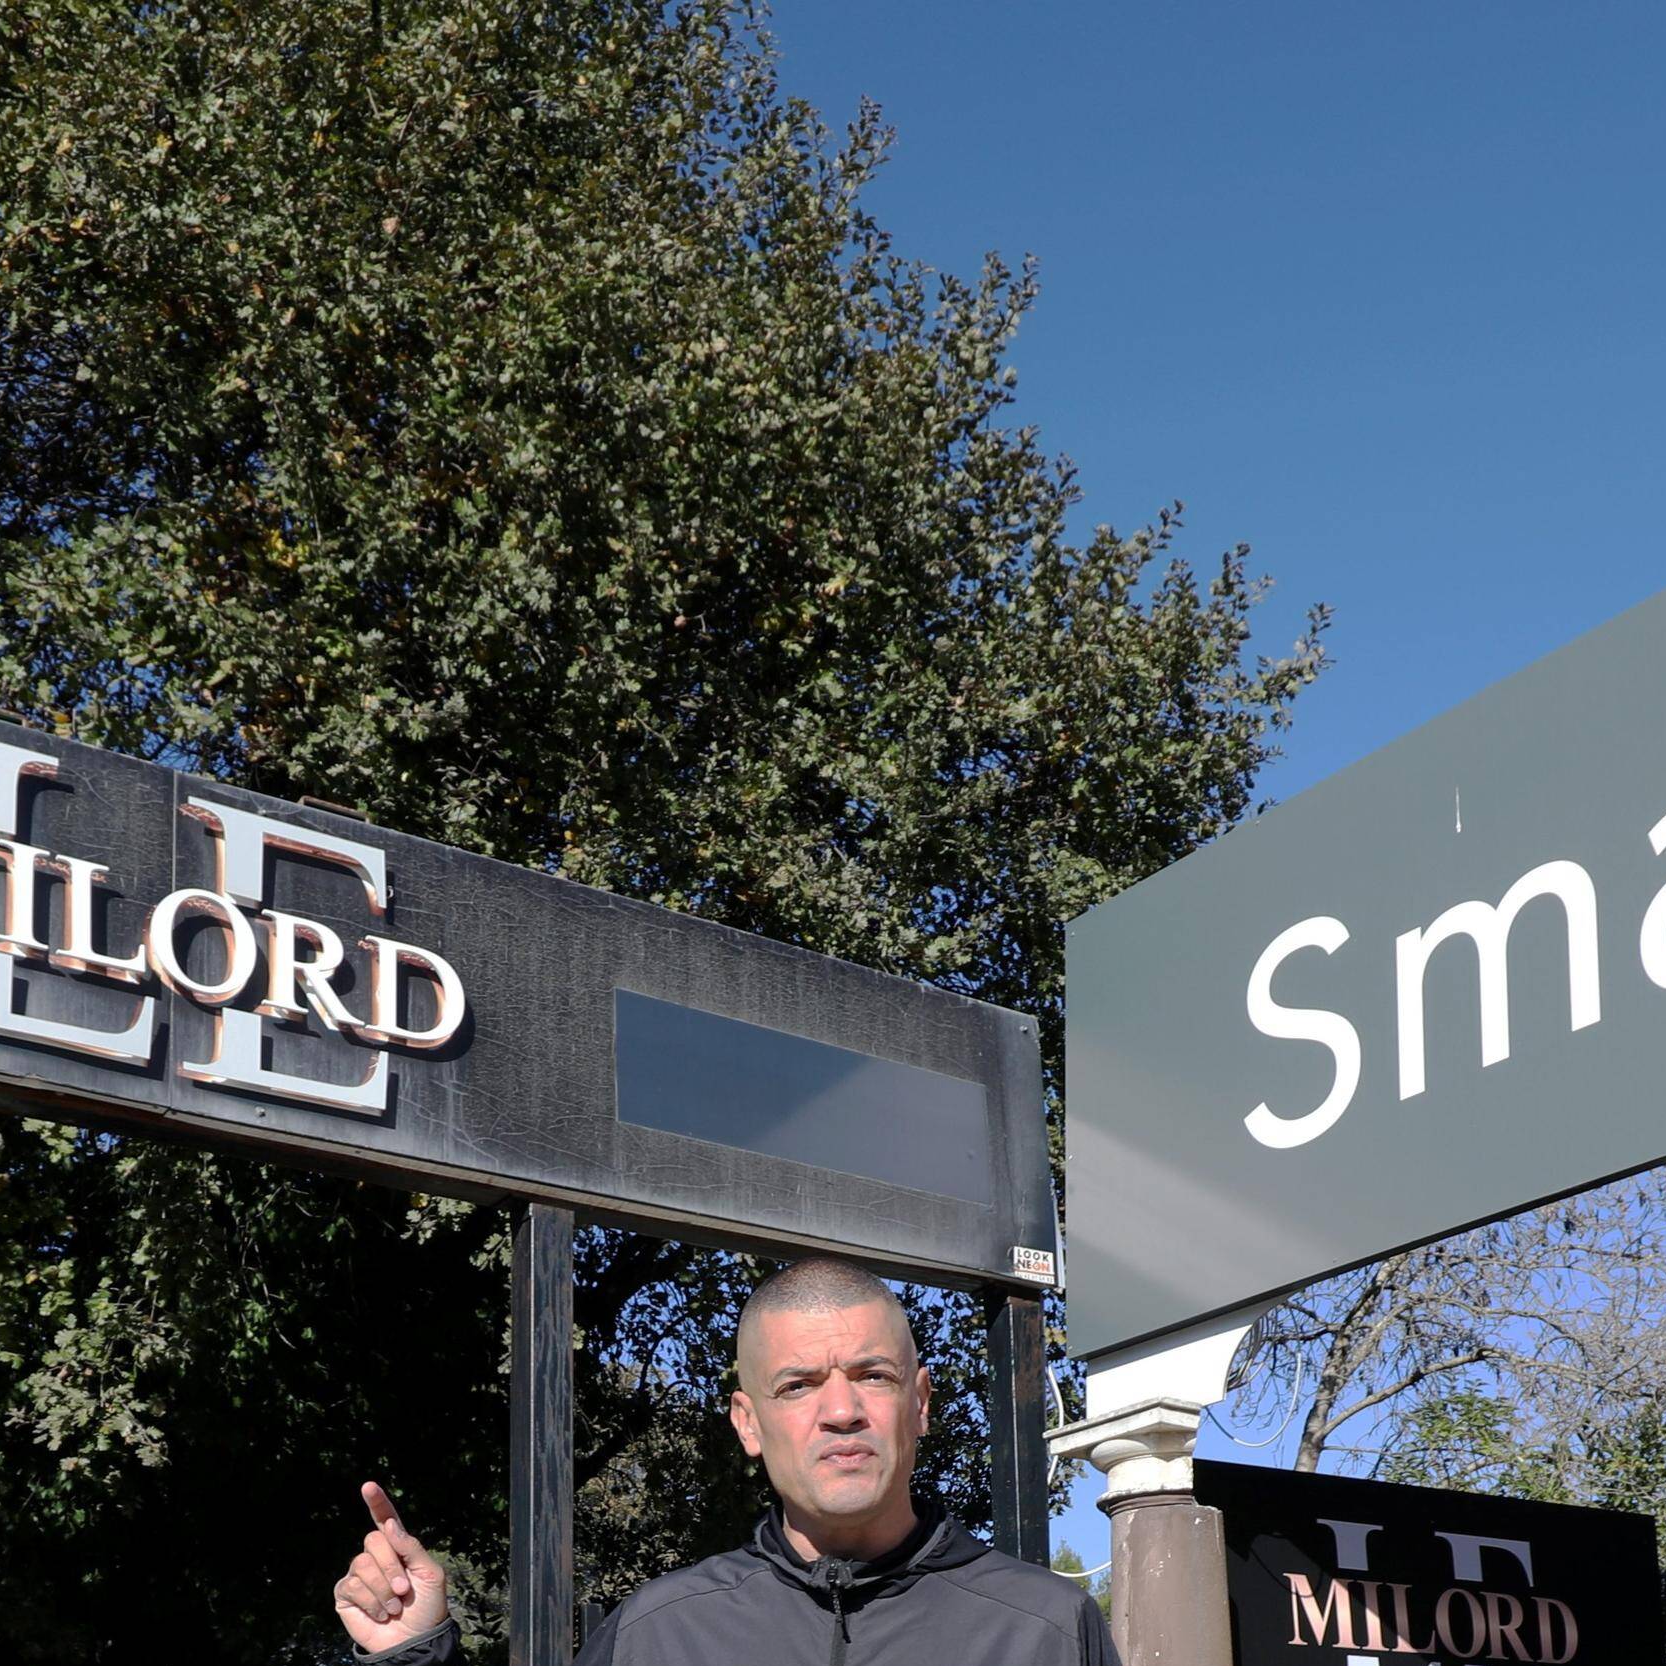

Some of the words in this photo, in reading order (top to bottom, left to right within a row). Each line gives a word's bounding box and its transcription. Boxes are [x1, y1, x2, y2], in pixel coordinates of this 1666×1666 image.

[1016, 1248, 1050, 1262] LOOK
[1016, 1259, 1051, 1273] NEON
[1282, 1572, 1579, 1665] MILORD
